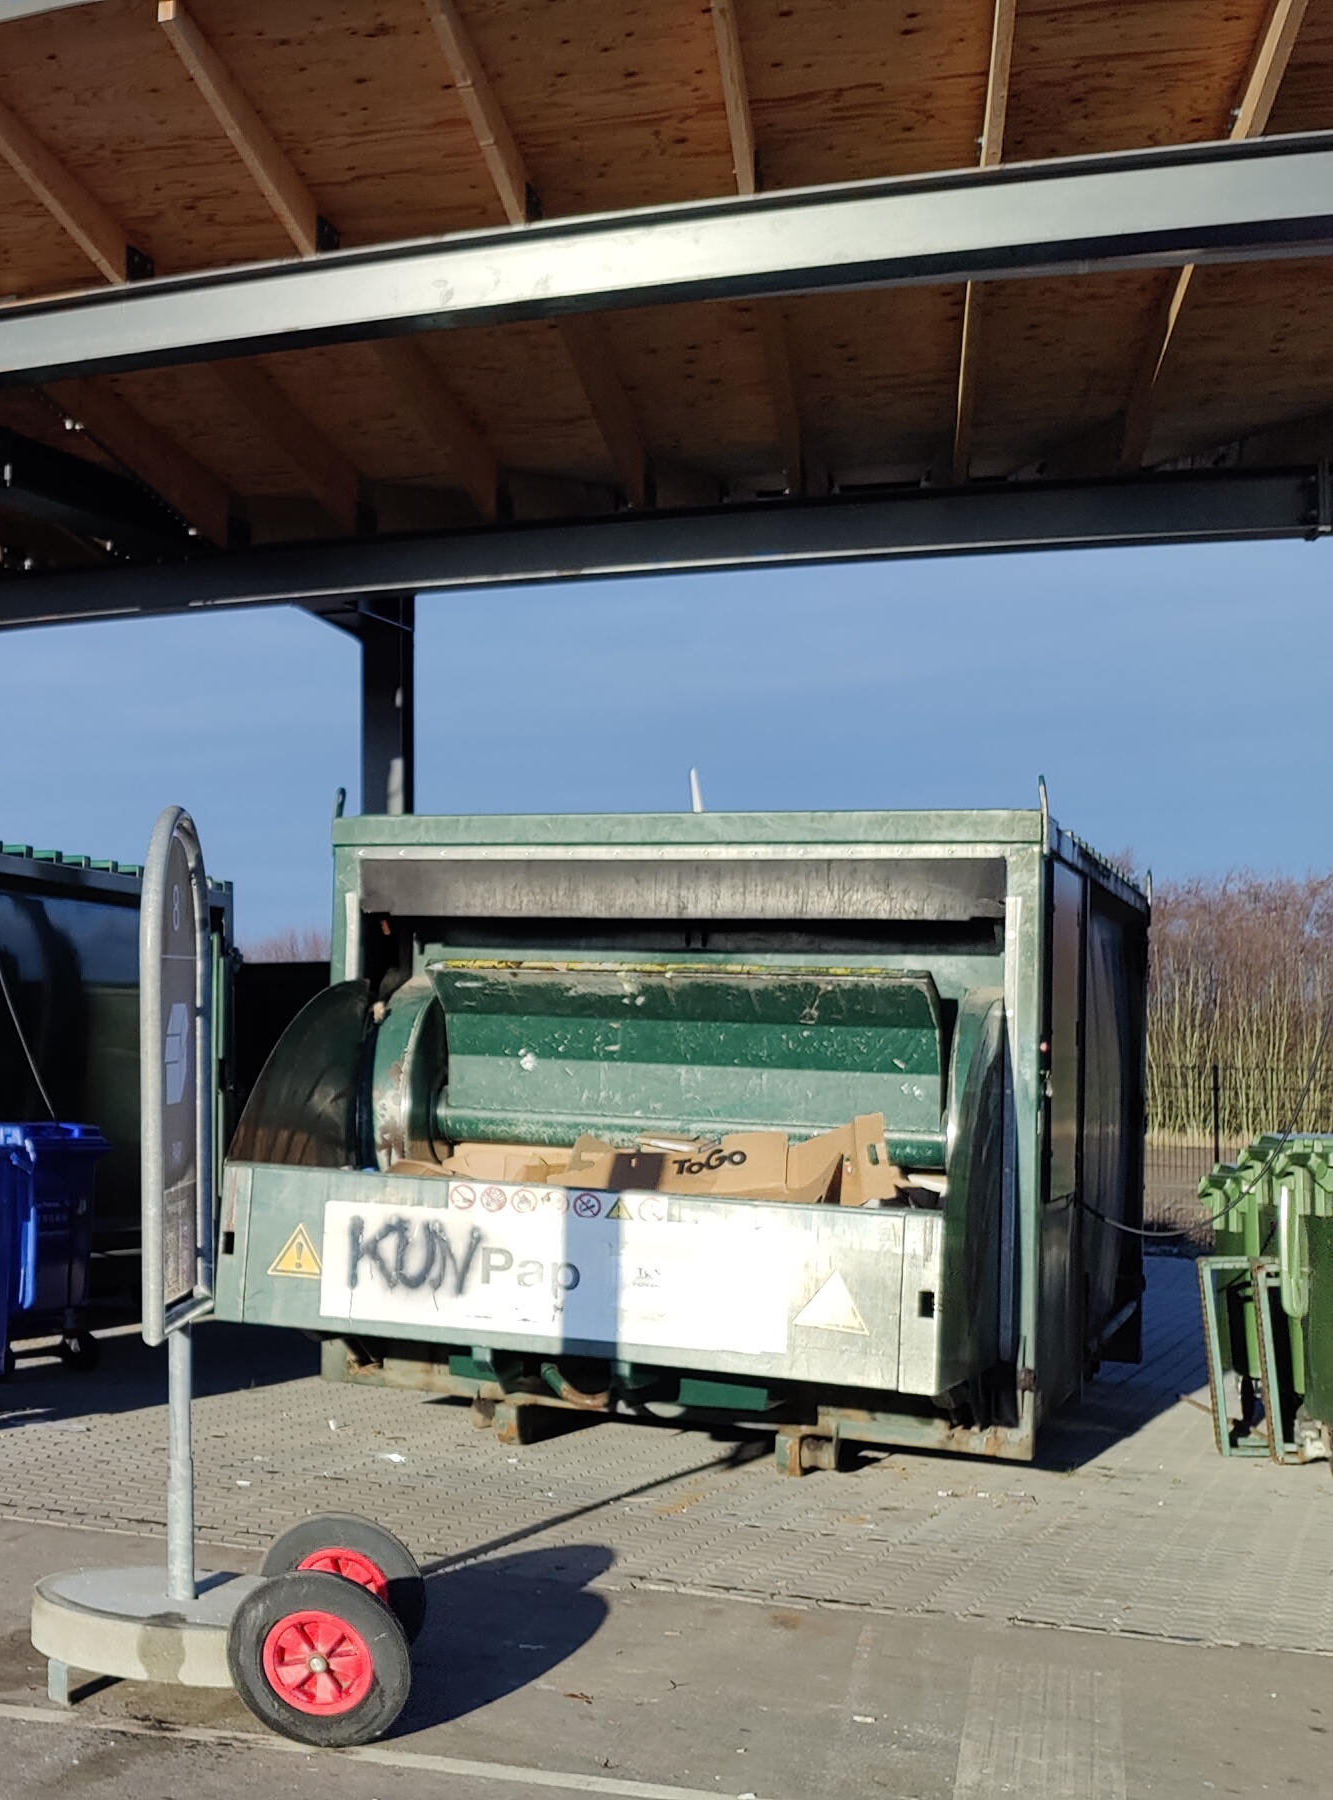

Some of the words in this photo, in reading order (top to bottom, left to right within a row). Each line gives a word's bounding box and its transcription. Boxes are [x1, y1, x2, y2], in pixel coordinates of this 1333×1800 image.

[172, 884, 180, 932] 8
[347, 1214, 483, 1296] KUN
[480, 1246, 580, 1299] Pap
